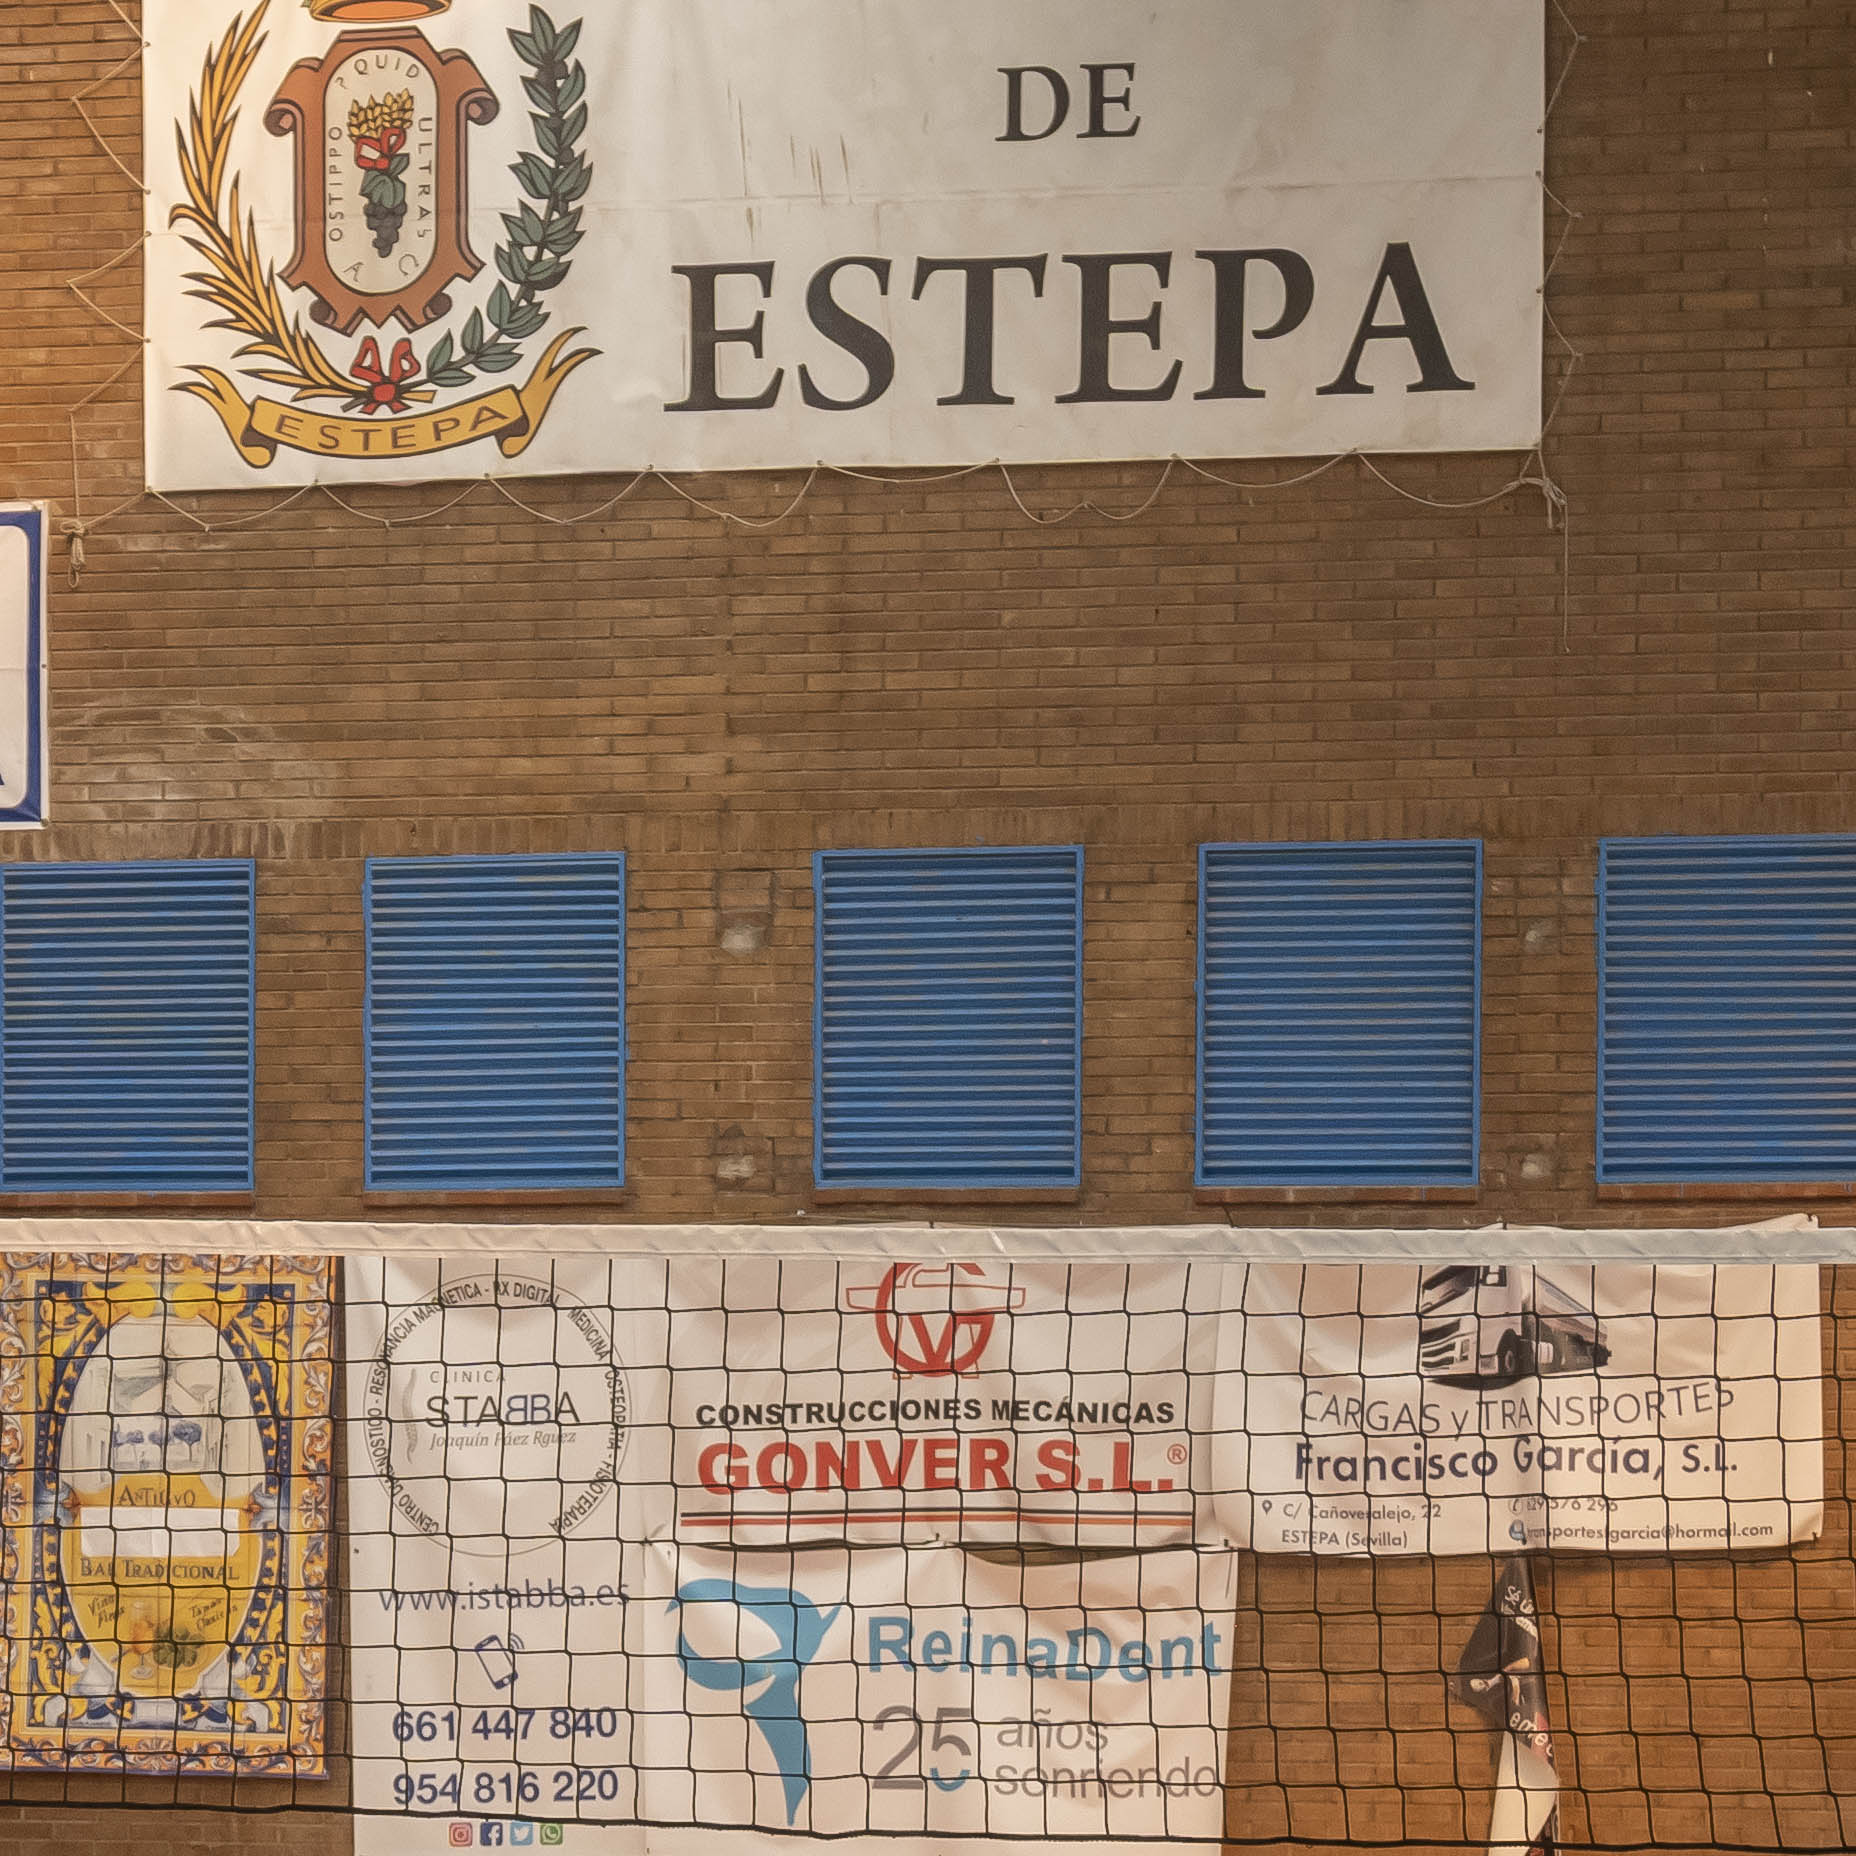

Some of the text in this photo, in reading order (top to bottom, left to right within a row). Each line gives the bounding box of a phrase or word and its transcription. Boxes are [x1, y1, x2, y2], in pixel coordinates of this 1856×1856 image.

[354, 54, 419, 78] QUID
[995, 61, 1141, 143] DE
[329, 127, 343, 242] OSTIPPO
[664, 240, 1476, 413] ESTEPA
[274, 405, 509, 451] ESTEPA
[696, 1397, 1174, 1426] CONSTRUCCIONES MECÁNICAS
[1300, 1389, 1441, 1434] CARGAS
[1477, 1382, 1734, 1431] TRANSPORTES
[698, 1438, 1011, 1495] GONVER
[1295, 1441, 1498, 1482] Francisco
[1681, 1444, 1738, 1474] S.L.
[1282, 1530, 1340, 1546] ESTEPA
[379, 1579, 629, 1611] www.istabba.es
[868, 1616, 1222, 1682] ReinaDent
[394, 1707, 616, 1741] 661 447 840
[996, 1708, 1109, 1751] años
[872, 1706, 972, 1791] 25
[394, 1770, 618, 1804] 954 816 220
[995, 1757, 1217, 1798] sonriendo
